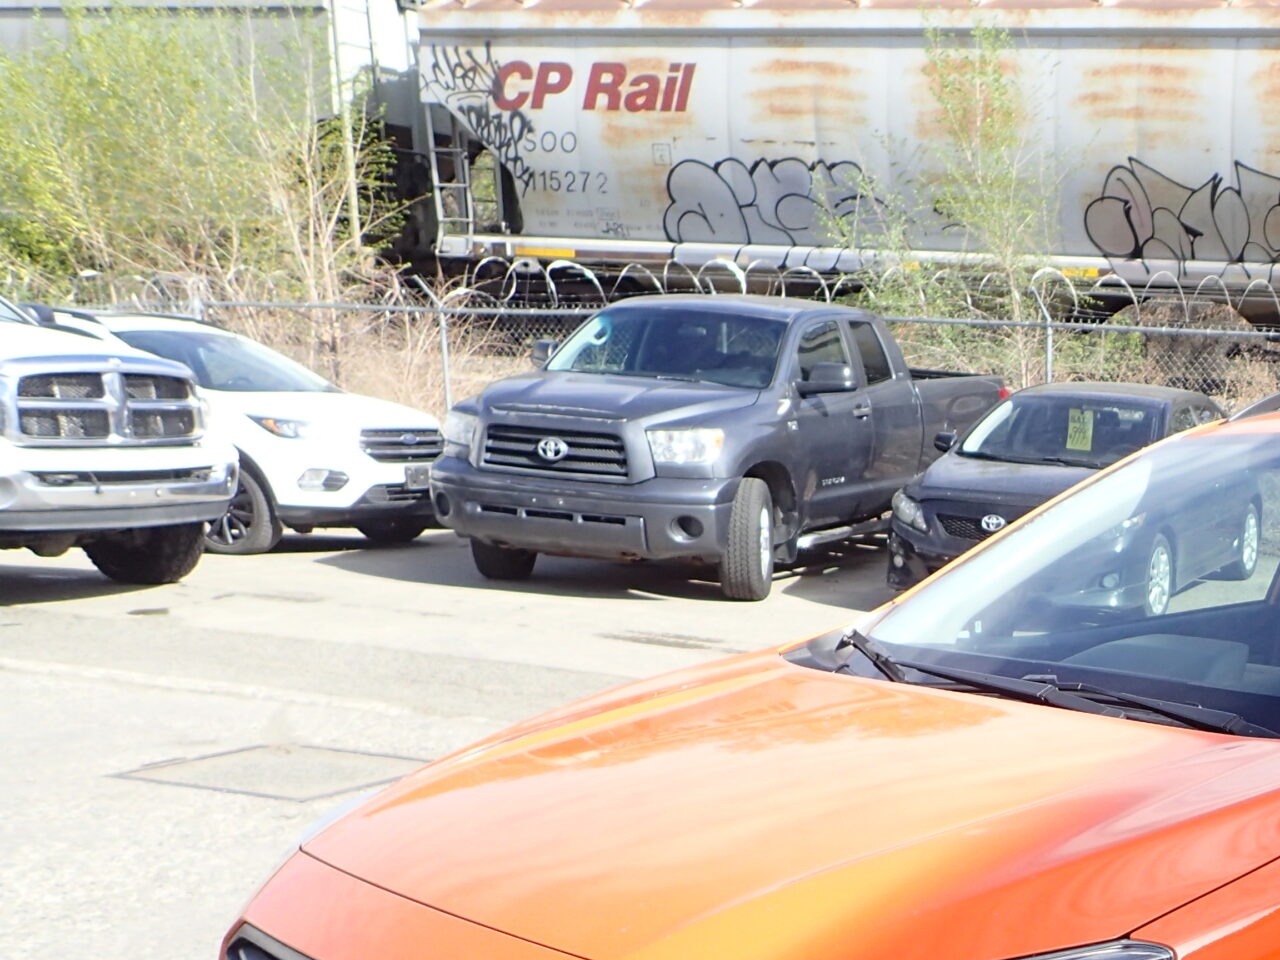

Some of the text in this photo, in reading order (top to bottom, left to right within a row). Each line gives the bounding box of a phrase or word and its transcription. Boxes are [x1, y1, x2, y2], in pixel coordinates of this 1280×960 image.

[492, 60, 573, 111] CP
[582, 62, 697, 112] Rail
[523, 131, 577, 153] SOO
